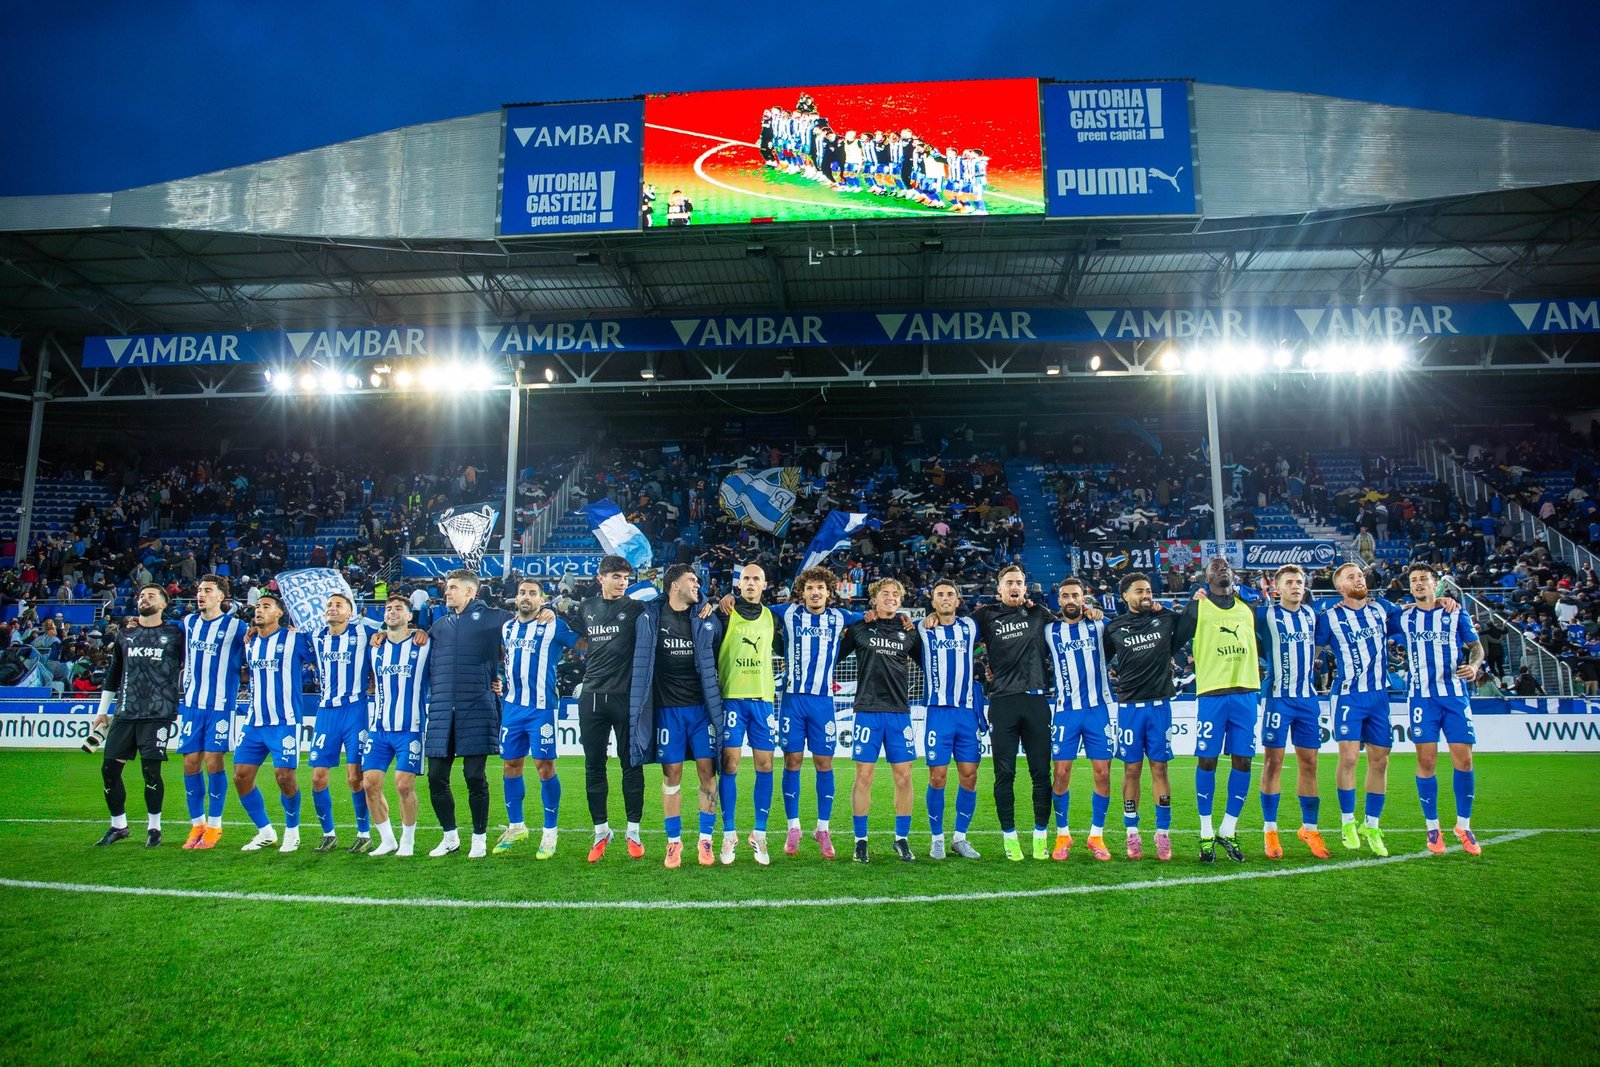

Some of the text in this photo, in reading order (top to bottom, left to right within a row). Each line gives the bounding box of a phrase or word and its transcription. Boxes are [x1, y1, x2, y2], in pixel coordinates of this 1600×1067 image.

[1068, 88, 1144, 109] VITORIA
[1070, 108, 1145, 129] GASTEIZ
[534, 122, 633, 148] AMBAR
[1077, 128, 1146, 142] green capital
[527, 171, 597, 193] VITORIA
[1056, 167, 1148, 196] PUMA
[526, 190, 597, 213] GASTEIZ
[531, 212, 596, 227] green capital
[906, 311, 1037, 341] AMBAR
[1116, 309, 1248, 338] AMBAR
[1326, 305, 1460, 337] AMBAR
[501, 321, 624, 352] AMBAR
[699, 315, 828, 346] AMBAR
[128, 334, 240, 364] AMBAR
[311, 327, 428, 358] AMBAR
[1083, 550, 1154, 569] 19 21
[587, 624, 620, 636] Silken
[995, 620, 1029, 636] Silken
[663, 638, 695, 648] Silke
[869, 637, 904, 650] Silken
[1124, 630, 1161, 647] Silken
[1132, 642, 1156, 652] HOTELES
[736, 658, 762, 667] Silke
[723, 711, 737, 728] 18
[1265, 712, 1282, 729] 19
[1341, 706, 1350, 721] 7
[1413, 707, 1423, 724] 8
[782, 717, 791, 734] 3
[854, 725, 870, 744] 30
[656, 728, 670, 746] 10
[928, 730, 936, 747] 6
